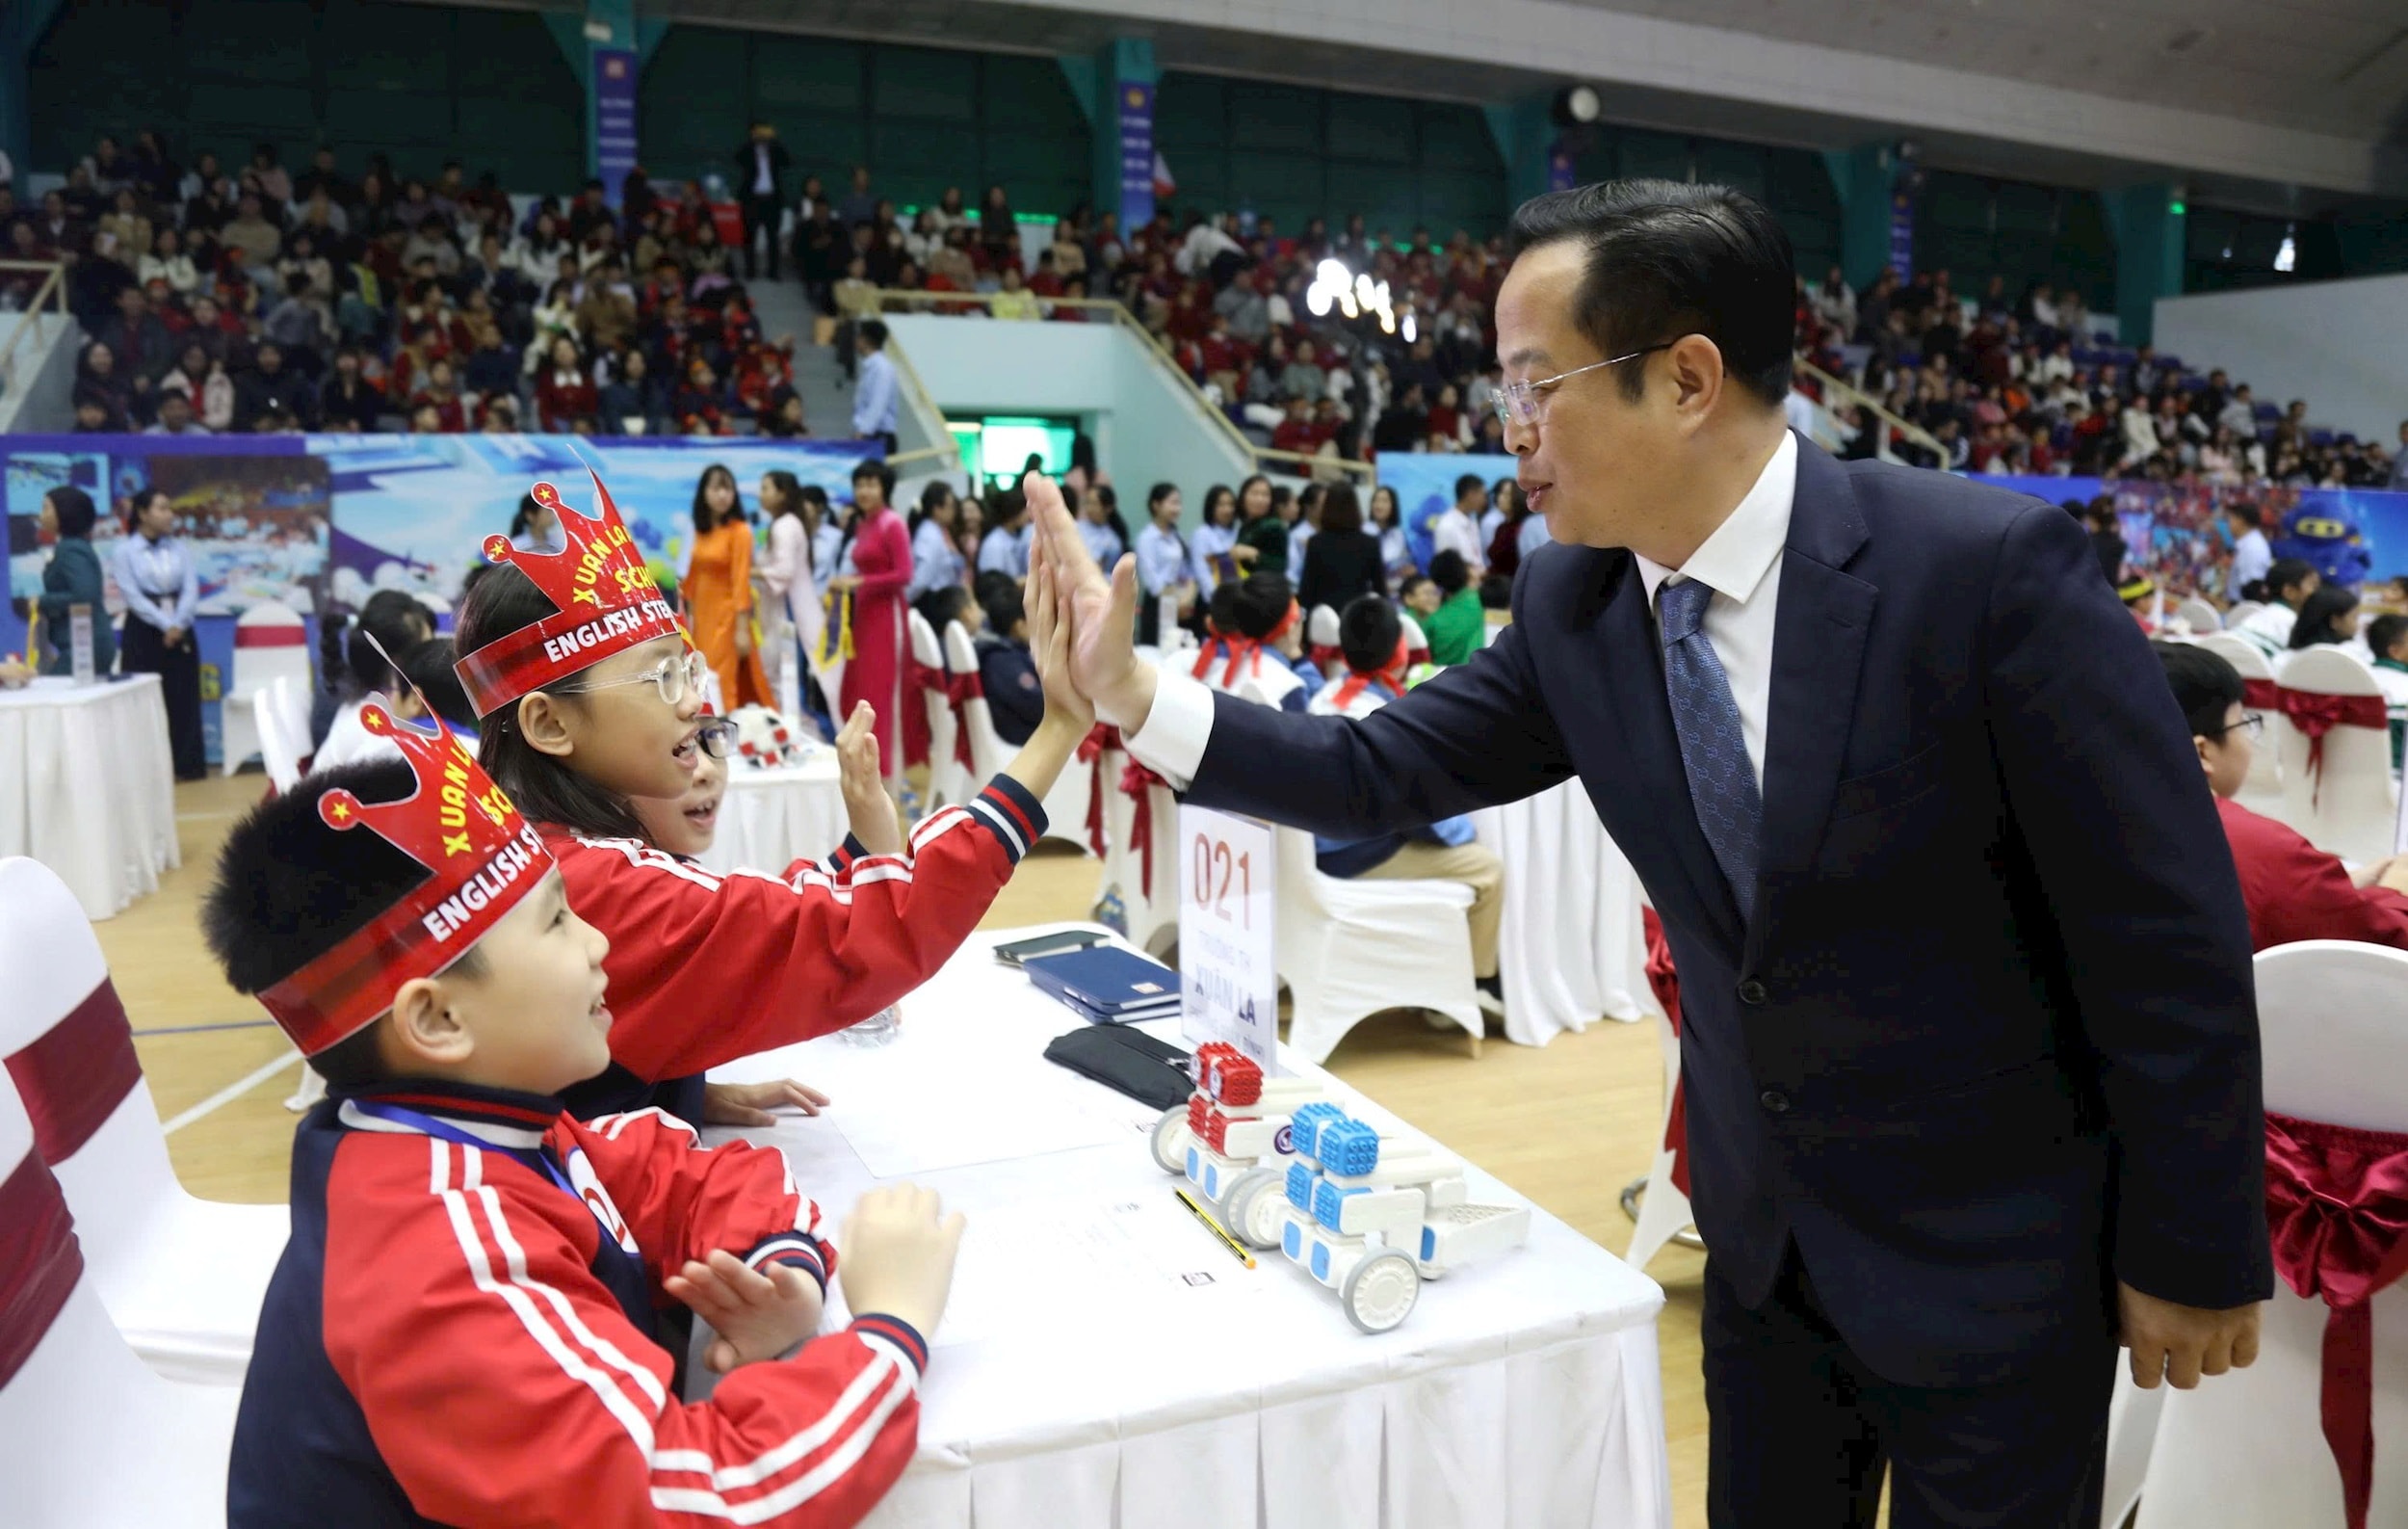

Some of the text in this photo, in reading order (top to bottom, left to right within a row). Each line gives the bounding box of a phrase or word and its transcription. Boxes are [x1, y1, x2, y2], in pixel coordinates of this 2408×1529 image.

[573, 538, 612, 605] XUAN
[615, 567, 655, 593] SCH
[542, 599, 674, 663] ENGLISH STE
[440, 760, 473, 858] XUAN
[481, 785, 514, 827] SC
[423, 839, 532, 943] ENGLISH
[1195, 832, 1250, 931] 021
